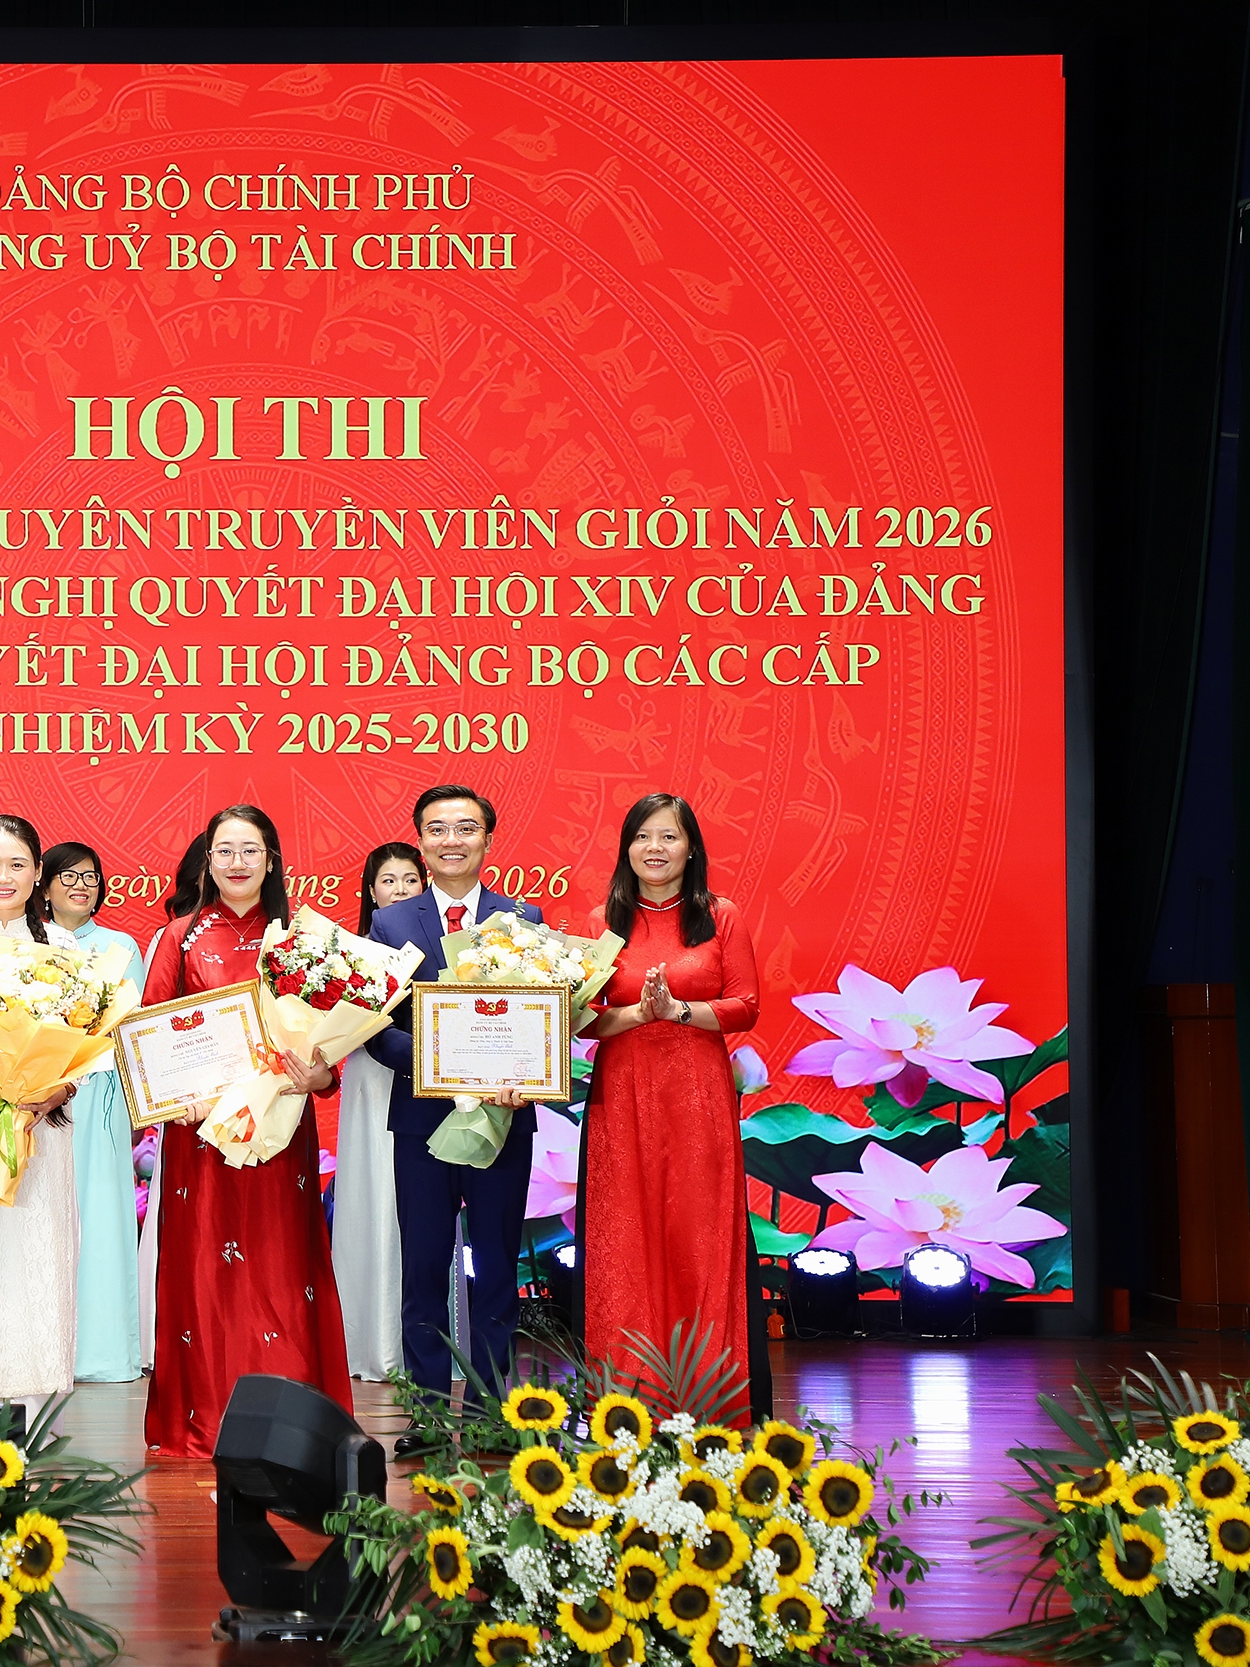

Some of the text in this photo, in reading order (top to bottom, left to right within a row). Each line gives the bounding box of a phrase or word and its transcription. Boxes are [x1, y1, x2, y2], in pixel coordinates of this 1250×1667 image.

[120, 163, 190, 225] BỘ
[204, 163, 361, 211] CHÍNH
[373, 164, 475, 211] PHỦ
[80, 223, 152, 271] UỶ
[165, 229, 237, 281] BỘ
[250, 225, 338, 270] TÀI
[352, 224, 517, 270] CHÍNH
[66, 386, 429, 479] HỘI THI
[165, 496, 409, 550] TRUYỀN
[416, 494, 560, 550] VIÊN
[576, 495, 711, 549] GIỎI
[724, 498, 863, 549] NĂM
[874, 506, 992, 548] 2026
[129, 564, 324, 627] QUYẾT
[335, 576, 437, 630] ĐẠI
[450, 571, 559, 630] HỘI
[570, 576, 675, 617] XIV
[687, 562, 808, 617] CỦA
[816, 561, 986, 616] ĐẢNG
[97, 645, 202, 699] ĐẠI
[217, 637, 329, 699] HỘI
[341, 632, 513, 686] ĐẢNG
[526, 640, 609, 699] BỘ
[623, 633, 748, 686] CÁC
[762, 631, 880, 685] CẤP
[181, 701, 265, 754] KỲ
[277, 712, 529, 754] 2025-2030
[102, 865, 172, 908] gày
[283, 865, 344, 908] áng
[484, 865, 572, 899] 2026
